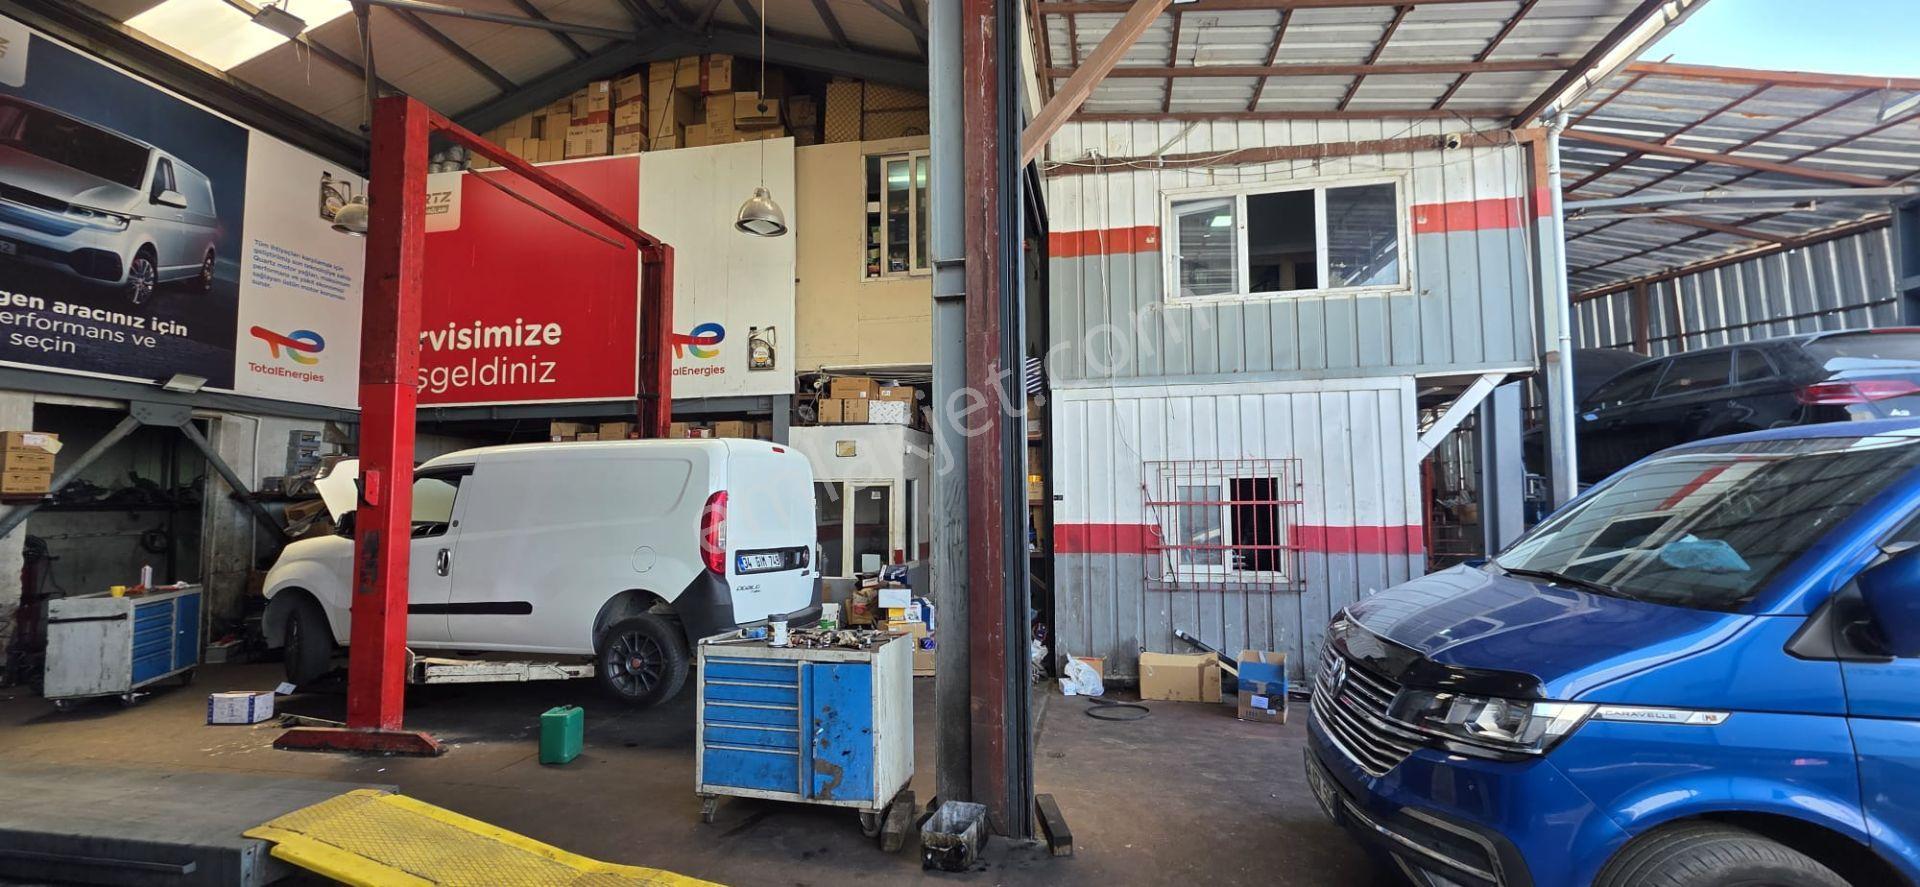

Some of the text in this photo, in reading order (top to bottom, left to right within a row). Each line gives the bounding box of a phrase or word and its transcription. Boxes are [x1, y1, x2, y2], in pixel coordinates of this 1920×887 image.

[0, 311, 157, 348] erformans ve
[52, 300, 145, 329] aracınız
[151, 317, 188, 337] için
[9, 331, 76, 354] seçin
[419, 317, 562, 352] rvisimize
[247, 361, 325, 382] TotalEnergies
[416, 354, 557, 394] şgeldiniz
[672, 364, 726, 377] alEnergies
[742, 556, 753, 569] 34
[1605, 710, 1677, 720] CARAVELLE
